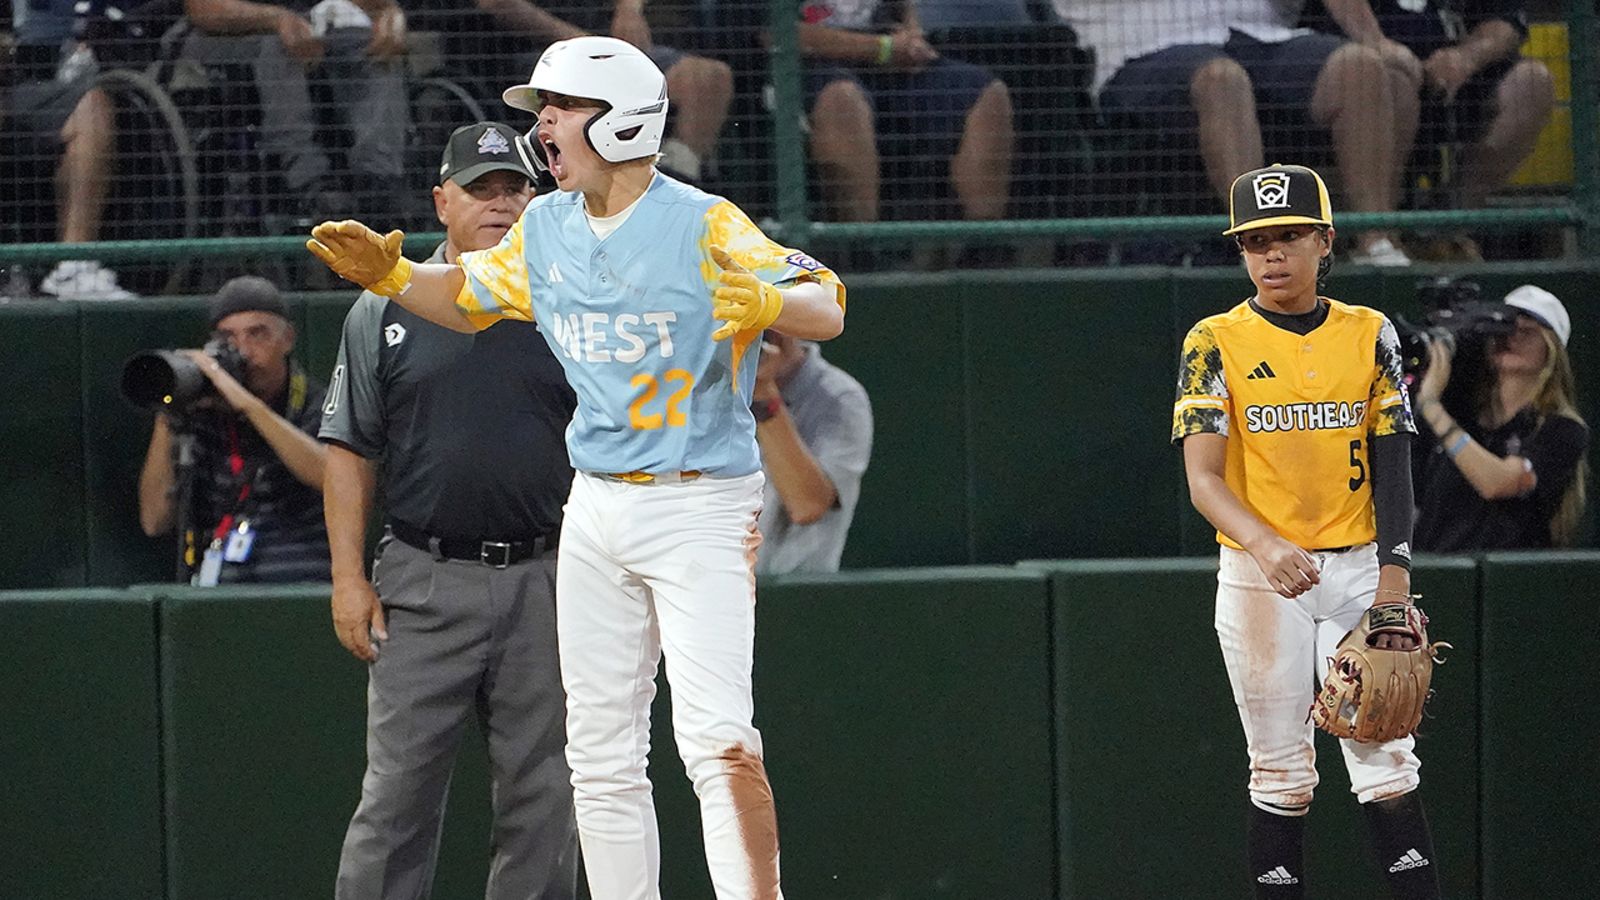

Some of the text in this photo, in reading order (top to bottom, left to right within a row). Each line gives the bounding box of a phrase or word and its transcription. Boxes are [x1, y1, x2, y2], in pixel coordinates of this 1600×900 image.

[553, 311, 677, 363] WEST
[628, 368, 694, 430] 22
[1348, 439, 1366, 492] 5
[1257, 875, 1298, 885] adidas
[1389, 858, 1429, 873] adidas
